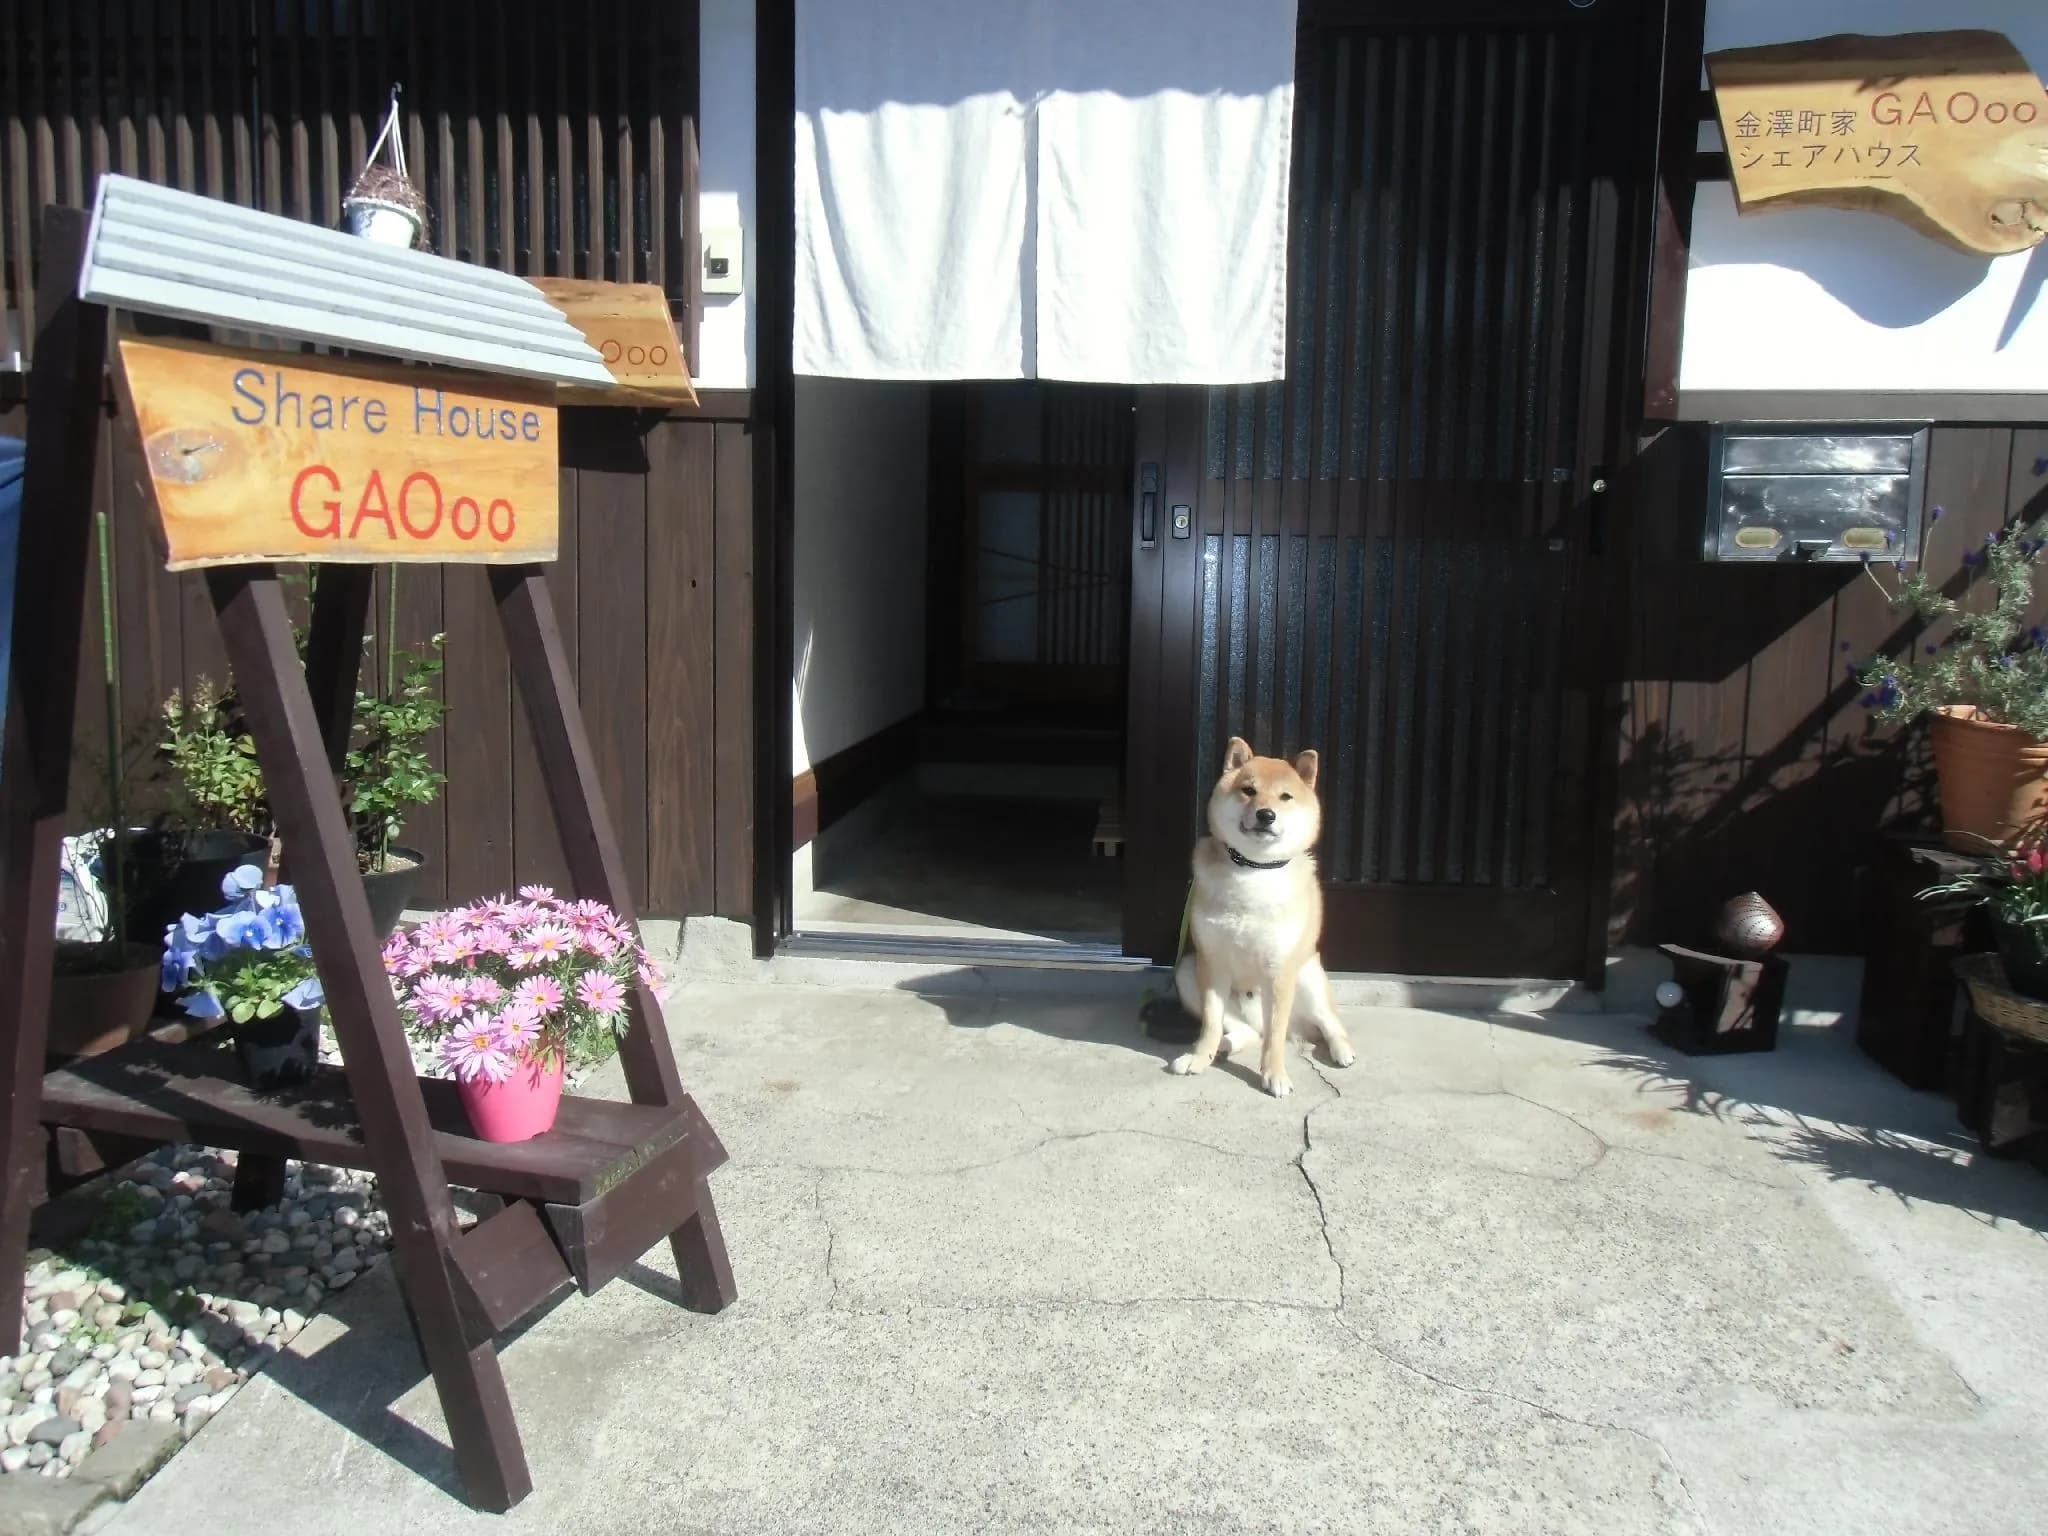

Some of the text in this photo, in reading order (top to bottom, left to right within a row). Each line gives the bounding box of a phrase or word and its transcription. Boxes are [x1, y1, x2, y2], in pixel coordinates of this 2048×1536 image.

[1735, 91, 2038, 138] 金澤町家 GAOoo
[1739, 142, 1921, 169] シェアハウス
[232, 368, 542, 442] Share House
[290, 464, 516, 542] GAOoo
